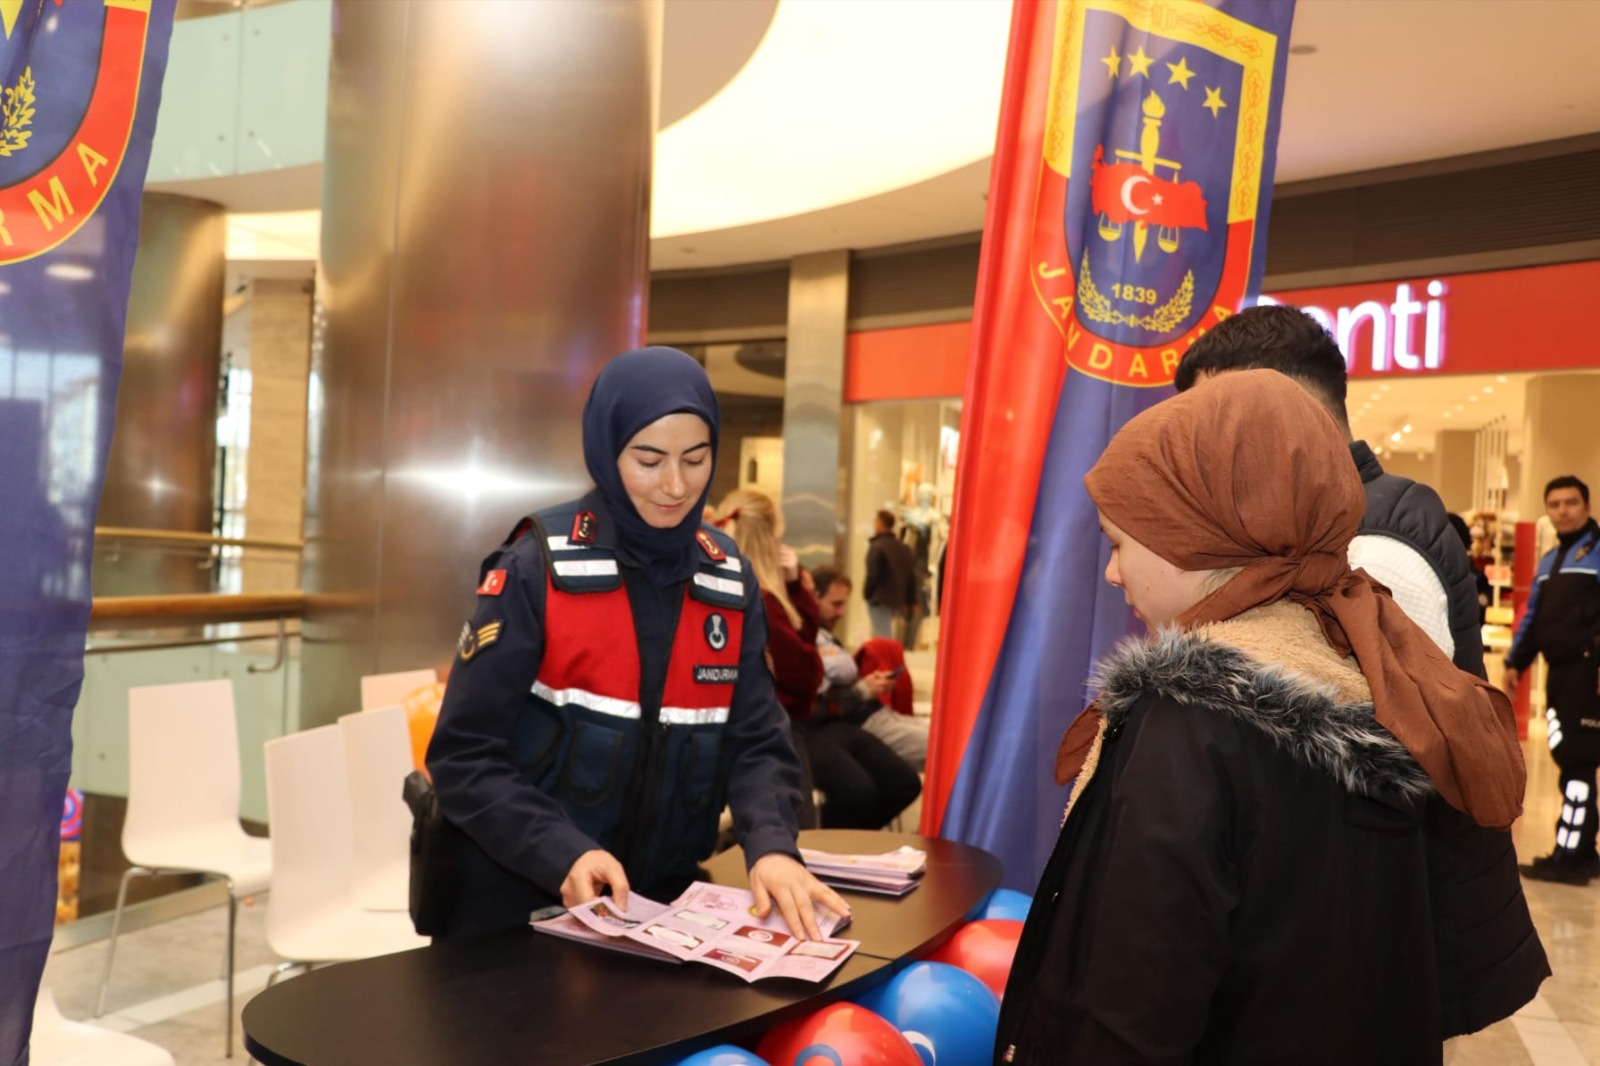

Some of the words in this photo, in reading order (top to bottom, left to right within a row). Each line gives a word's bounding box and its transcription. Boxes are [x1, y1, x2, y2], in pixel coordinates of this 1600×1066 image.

[1037, 261, 1232, 379] JANDARA
[1111, 283, 1157, 305] 1839
[1256, 279, 1442, 372] nti
